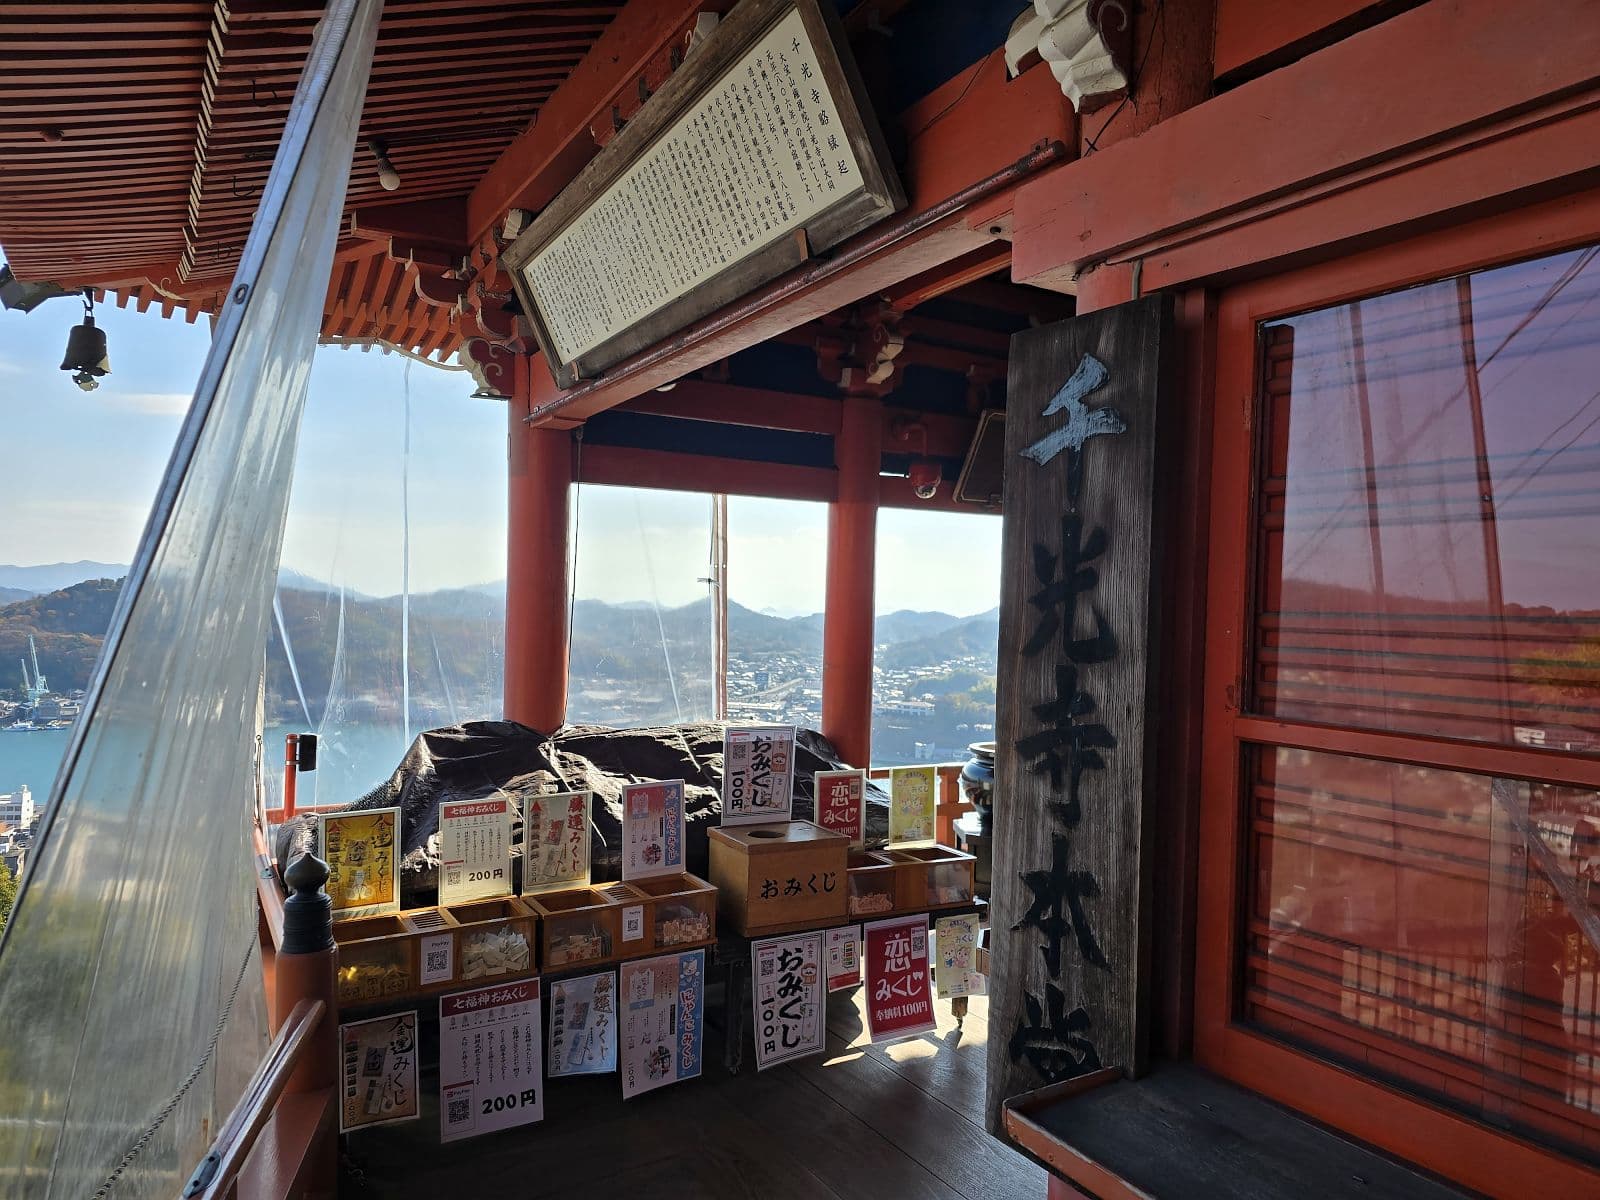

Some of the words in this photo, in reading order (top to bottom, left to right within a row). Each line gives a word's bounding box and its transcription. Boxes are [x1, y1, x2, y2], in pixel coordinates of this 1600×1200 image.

[789, 35, 848, 176] 千光寺略縁起
[1009, 353, 1127, 1084] 千光寺本堂
[751, 736, 772, 806] おみくじ
[831, 782, 850, 806] 恋
[452, 804, 499, 816] 七福神おみくじ
[567, 795, 586, 872] 勝運みくじ
[666, 807, 677, 861] にゃんこみくじ
[823, 808, 858, 824] みくじ
[369, 813, 395, 894] 金運みくじ
[469, 869, 503, 882] 200円
[761, 871, 836, 899] おみくじ
[884, 933, 911, 973] 恋
[453, 985, 529, 1010] 七福神おみくじ
[777, 948, 804, 1049] おみくじ
[876, 972, 924, 1001] みくじ
[593, 975, 613, 1061] 勝運みくじ
[680, 988, 696, 1070] にゃんこみくじ
[761, 998, 776, 1055] 一〇〇円
[386, 1017, 414, 1106] 金運みくじ
[482, 1089, 536, 1115] 200円
